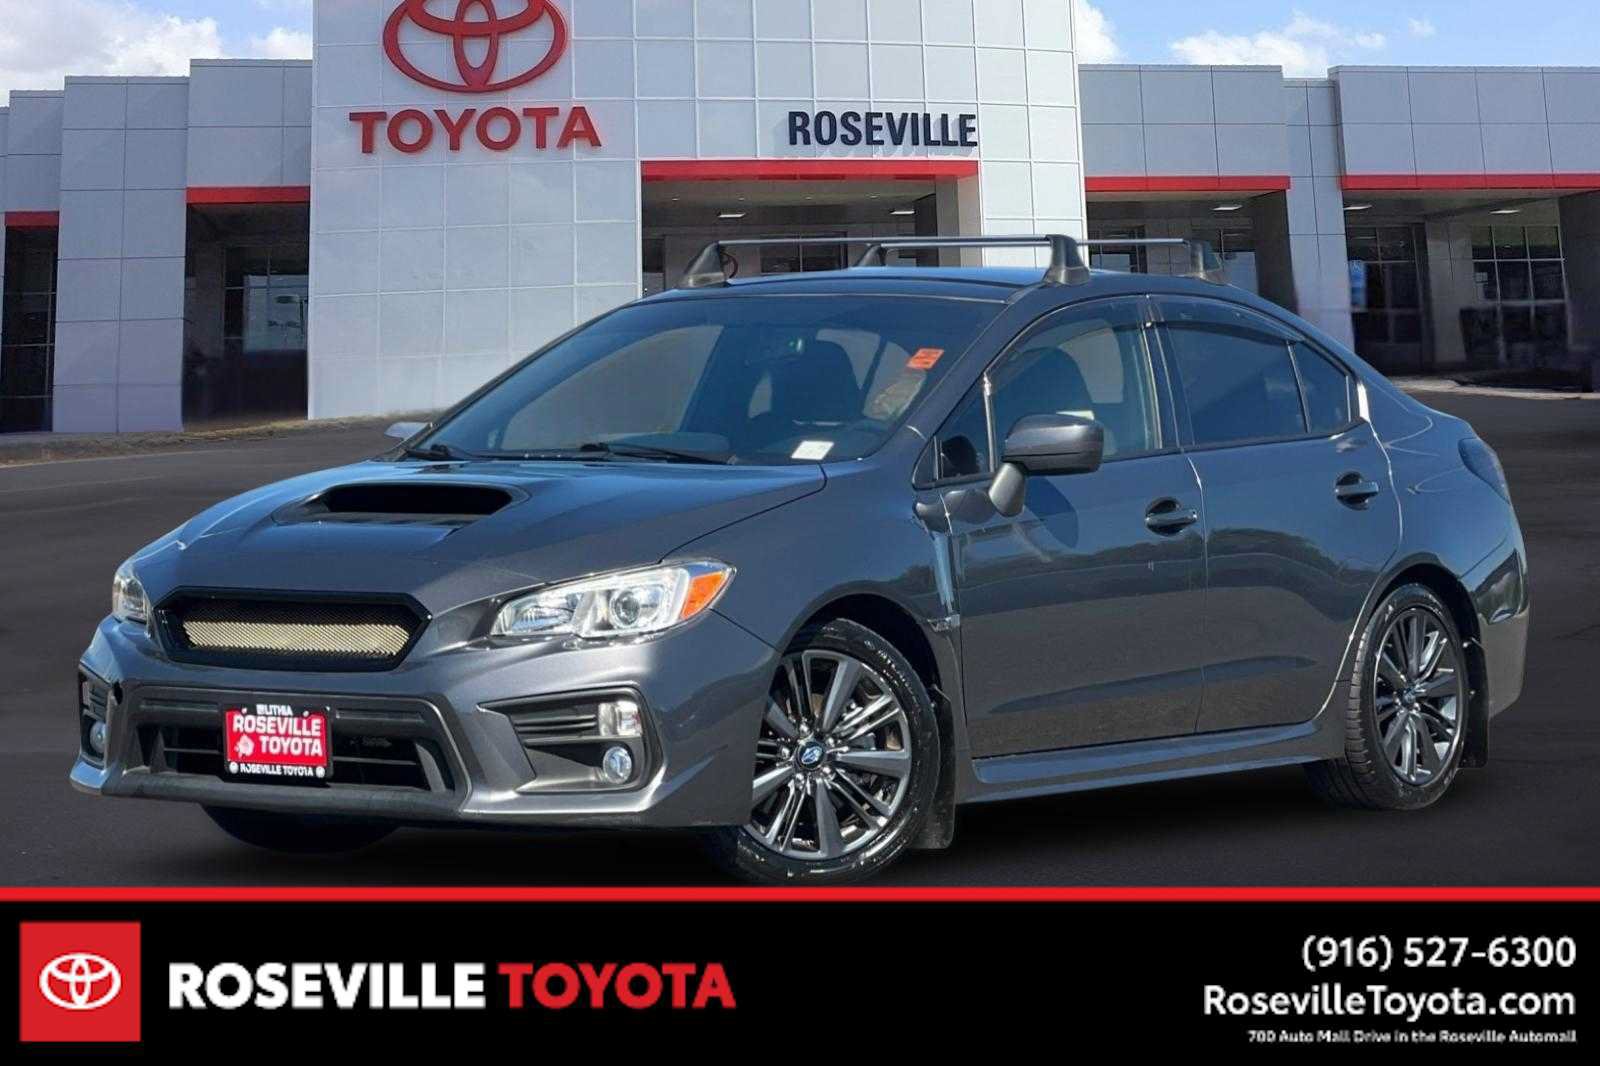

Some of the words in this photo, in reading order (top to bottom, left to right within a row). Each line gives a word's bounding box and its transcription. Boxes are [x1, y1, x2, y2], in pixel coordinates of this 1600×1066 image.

[348, 106, 602, 154] TOYOTA
[788, 111, 978, 147] ROSEVILLE
[232, 715, 322, 736] ROSEVILLE
[260, 736, 323, 756] TOYOTA
[240, 763, 282, 775] ROSEVILLE
[283, 765, 314, 776] TOYOTA
